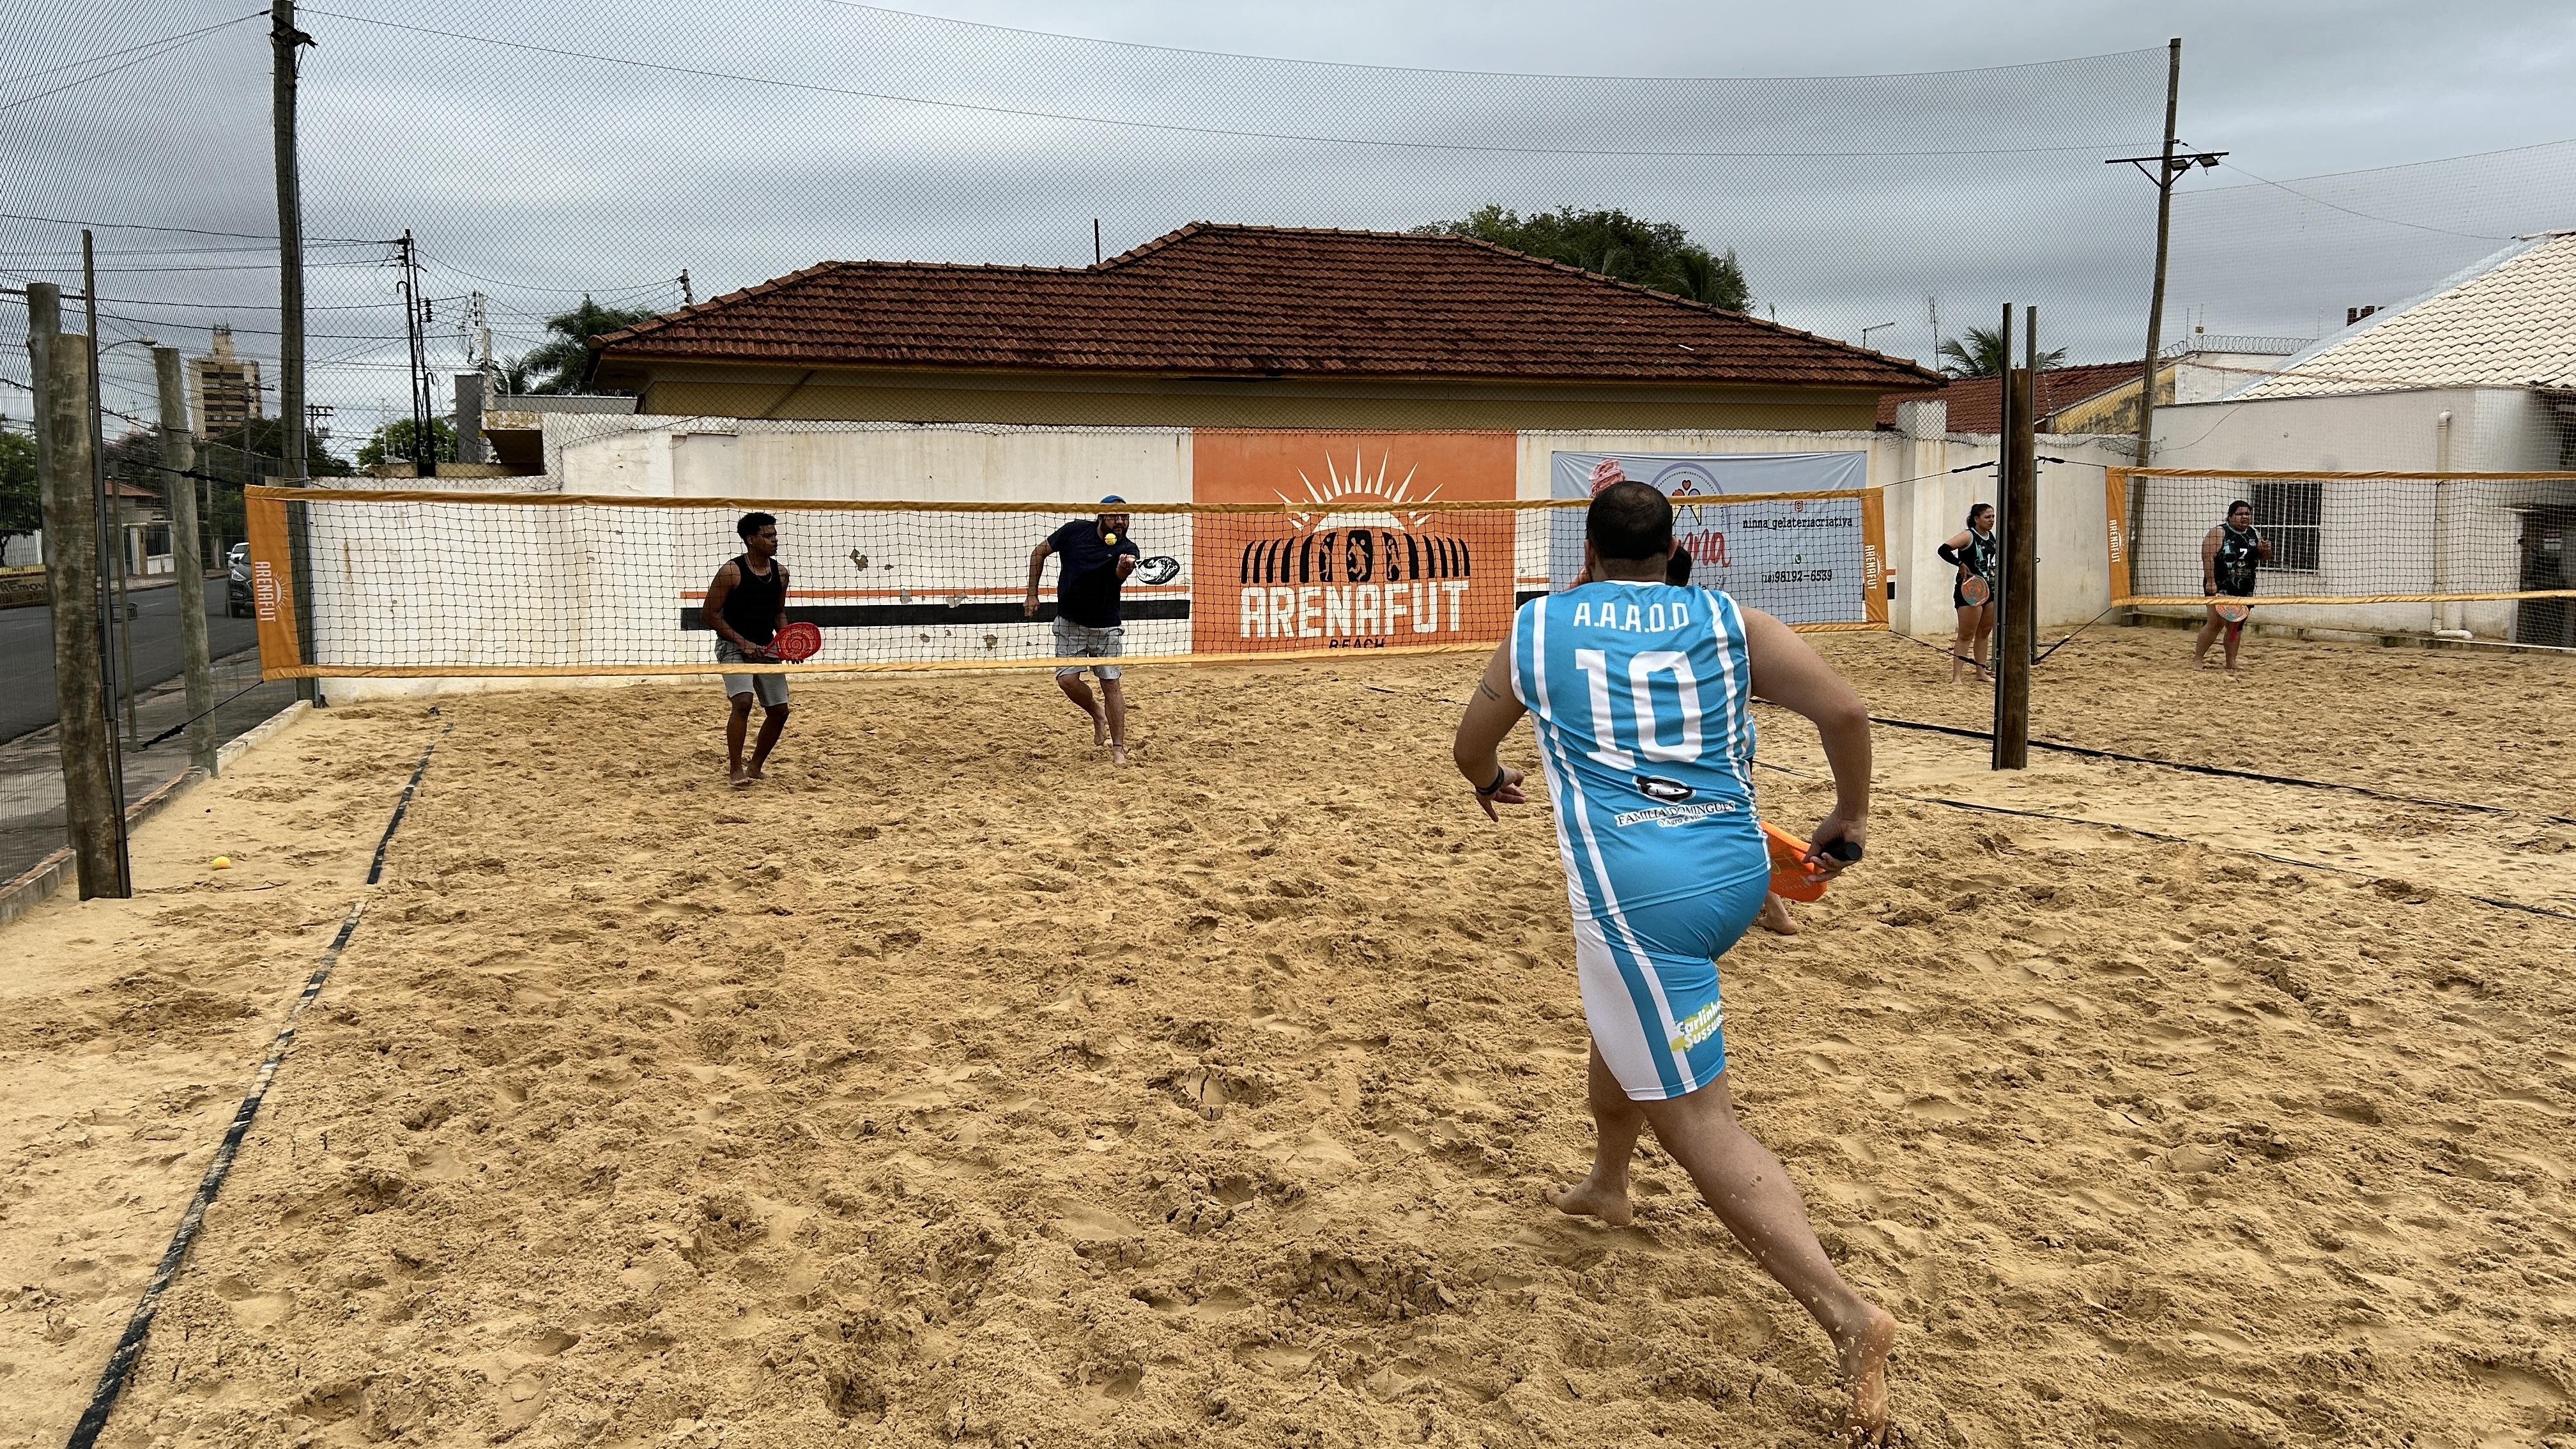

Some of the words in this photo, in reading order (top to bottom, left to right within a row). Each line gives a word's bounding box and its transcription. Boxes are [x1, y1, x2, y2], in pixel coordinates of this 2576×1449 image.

[1743, 516, 1853, 530] ninna_gelateriacriativa
[2109, 519, 2120, 563] ARENAFUT
[1864, 545, 1878, 590] ARENAFUT
[2239, 548, 2248, 560] 7
[254, 561, 276, 622] ARENAFUT
[1761, 569, 1832, 584] (18)98192-6539
[1240, 580, 1469, 638] ARENAFUT
[1574, 602, 1690, 633] A.A.A.O.D
[1575, 648, 1703, 770] 10
[1617, 808, 1667, 825] FAMILIA
[1669, 802, 1735, 816] DOMINGUES
